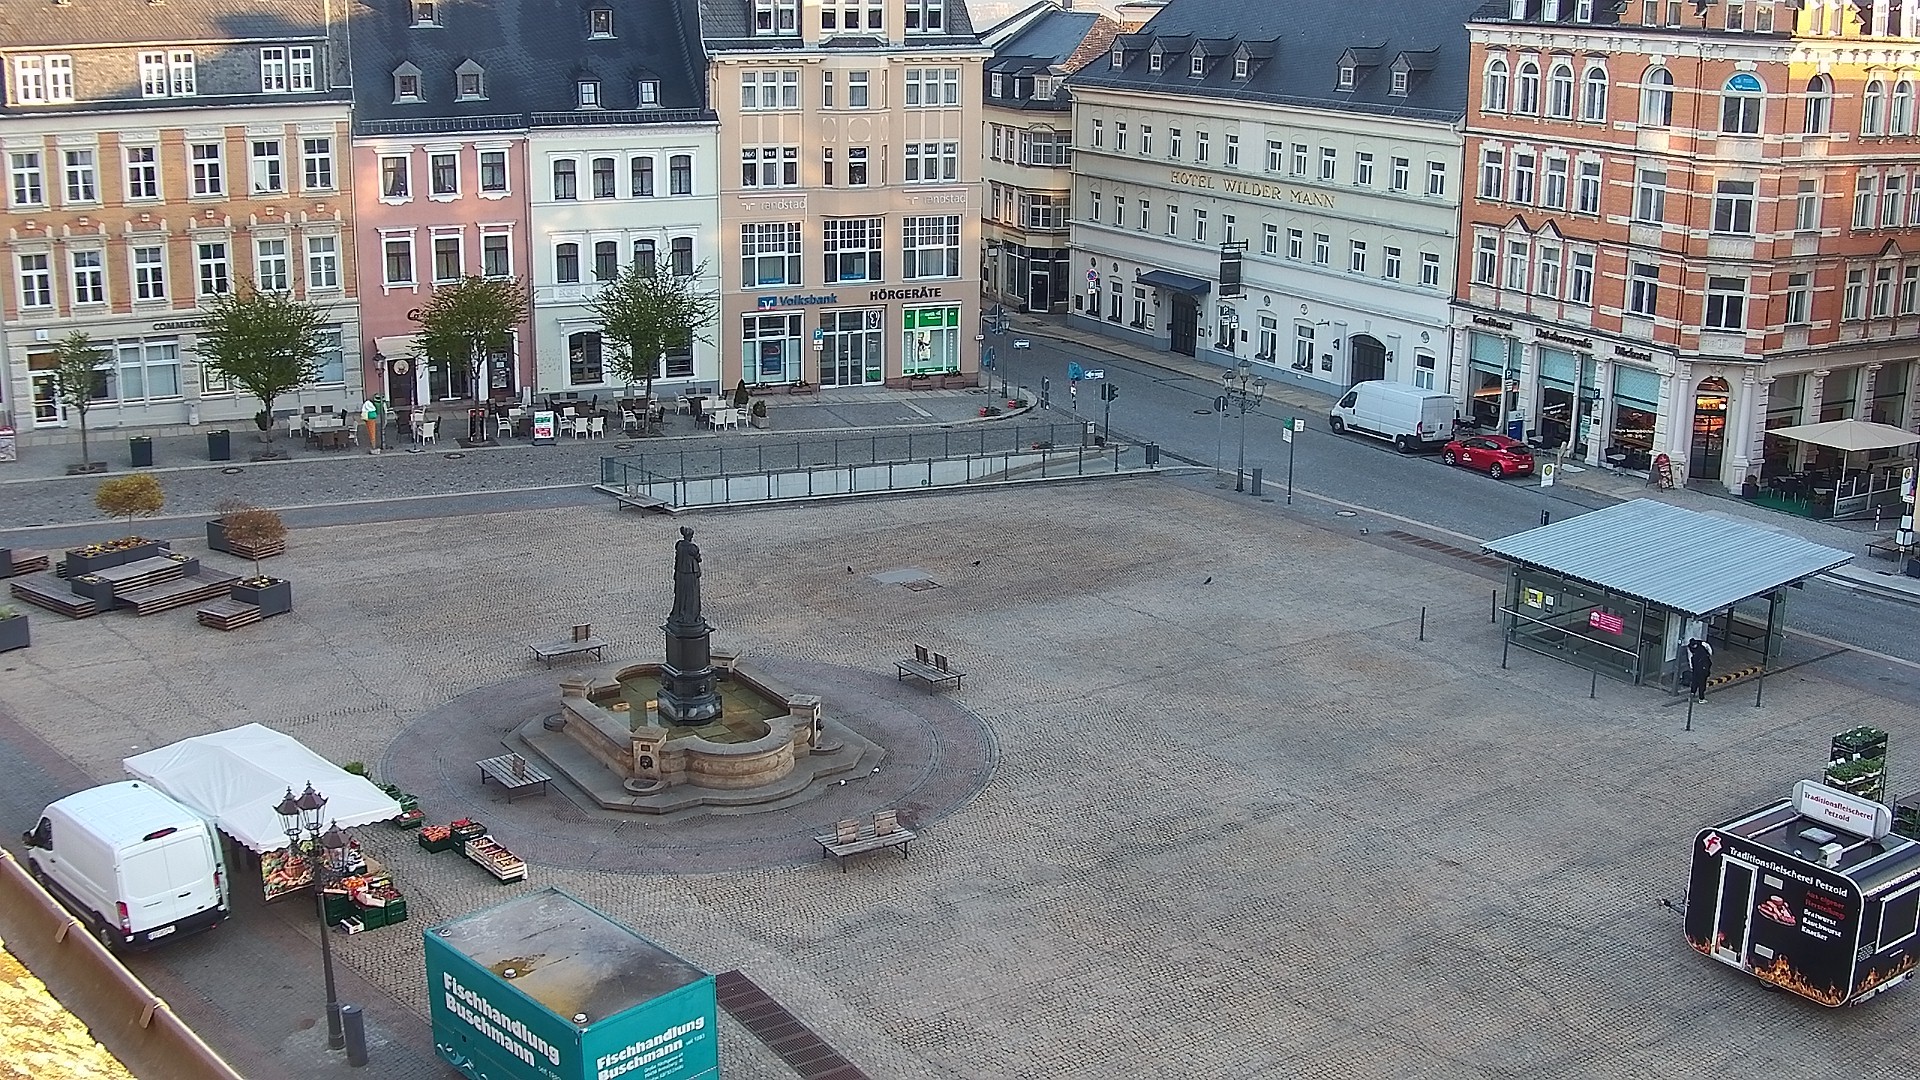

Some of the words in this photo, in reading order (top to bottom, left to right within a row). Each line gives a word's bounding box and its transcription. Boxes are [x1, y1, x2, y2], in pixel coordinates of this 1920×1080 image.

[921, 193, 966, 204] randstad
[1170, 170, 1215, 189] HOTEL
[1222, 178, 1282, 201] WILDER
[1289, 189, 1336, 209] MANN
[759, 198, 807, 210] randstad
[778, 293, 838, 306] Volksbank
[869, 286, 942, 301] HÖRGERÄTE
[1472, 314, 1513, 331] Konditorei
[1804, 791, 1874, 821] Traditionsfleischerei
[1824, 808, 1850, 822] Petzold
[1729, 846, 1814, 885] Traditionsfleischerei
[1815, 878, 1848, 897] Petzold
[1803, 908, 1837, 927] Bratwurst
[443, 971, 560, 1066] Fischhandlung
[445, 991, 535, 1068] Buschmann
[596, 1016, 705, 1071] Fischhandlung
[598, 1039, 683, 1080] Buschmann
